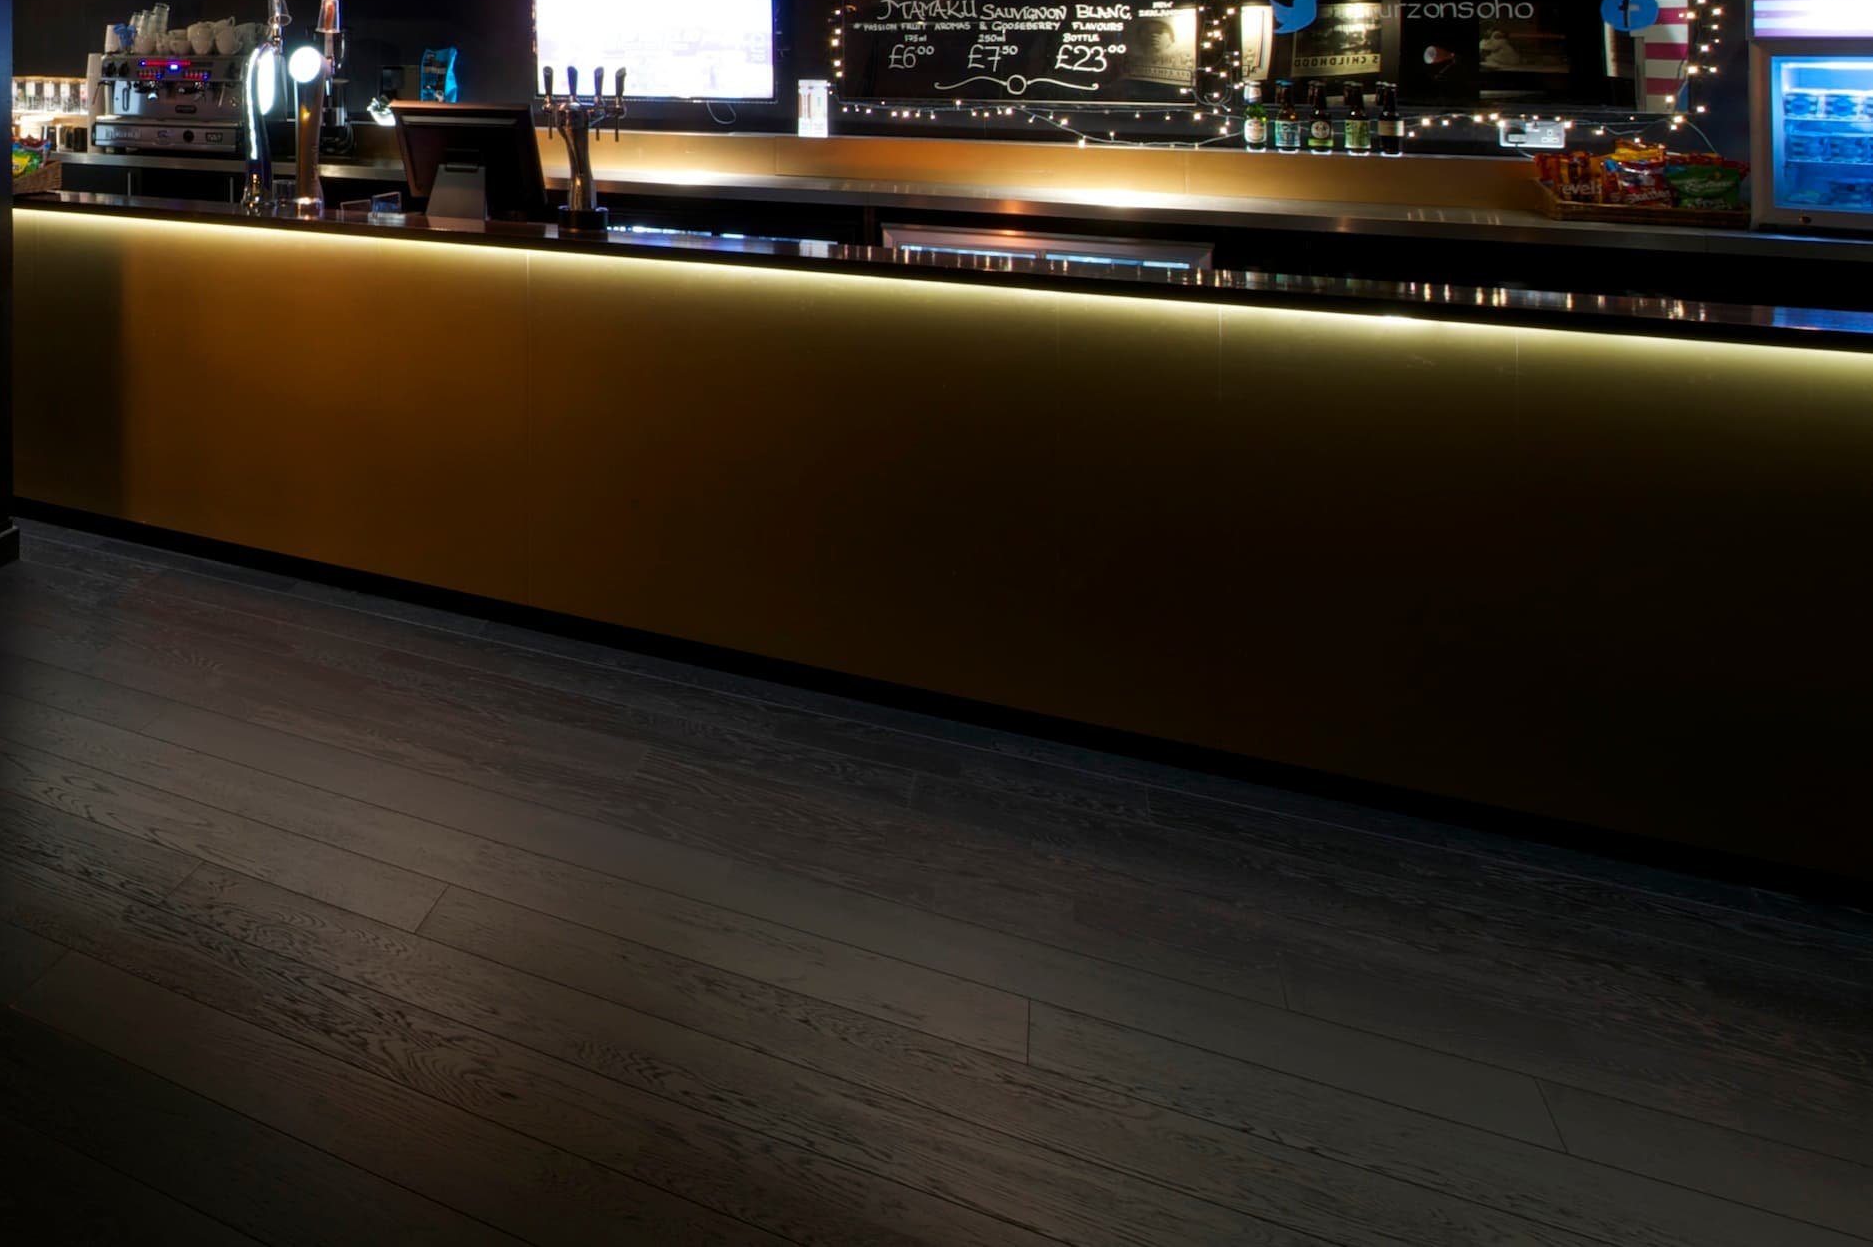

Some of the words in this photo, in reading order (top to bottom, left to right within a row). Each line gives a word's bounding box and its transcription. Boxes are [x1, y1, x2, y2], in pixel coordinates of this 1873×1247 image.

[980, 3, 1067, 20] SAUVIGNON
[934, 21, 971, 31] AROMAS
[979, 21, 988, 31] &
[992, 21, 1061, 31] GOOSEBERRY
[1071, 21, 1124, 32] FLAVOURS
[978, 32, 1006, 43] 250ml
[1063, 32, 1100, 42] BOTTLE
